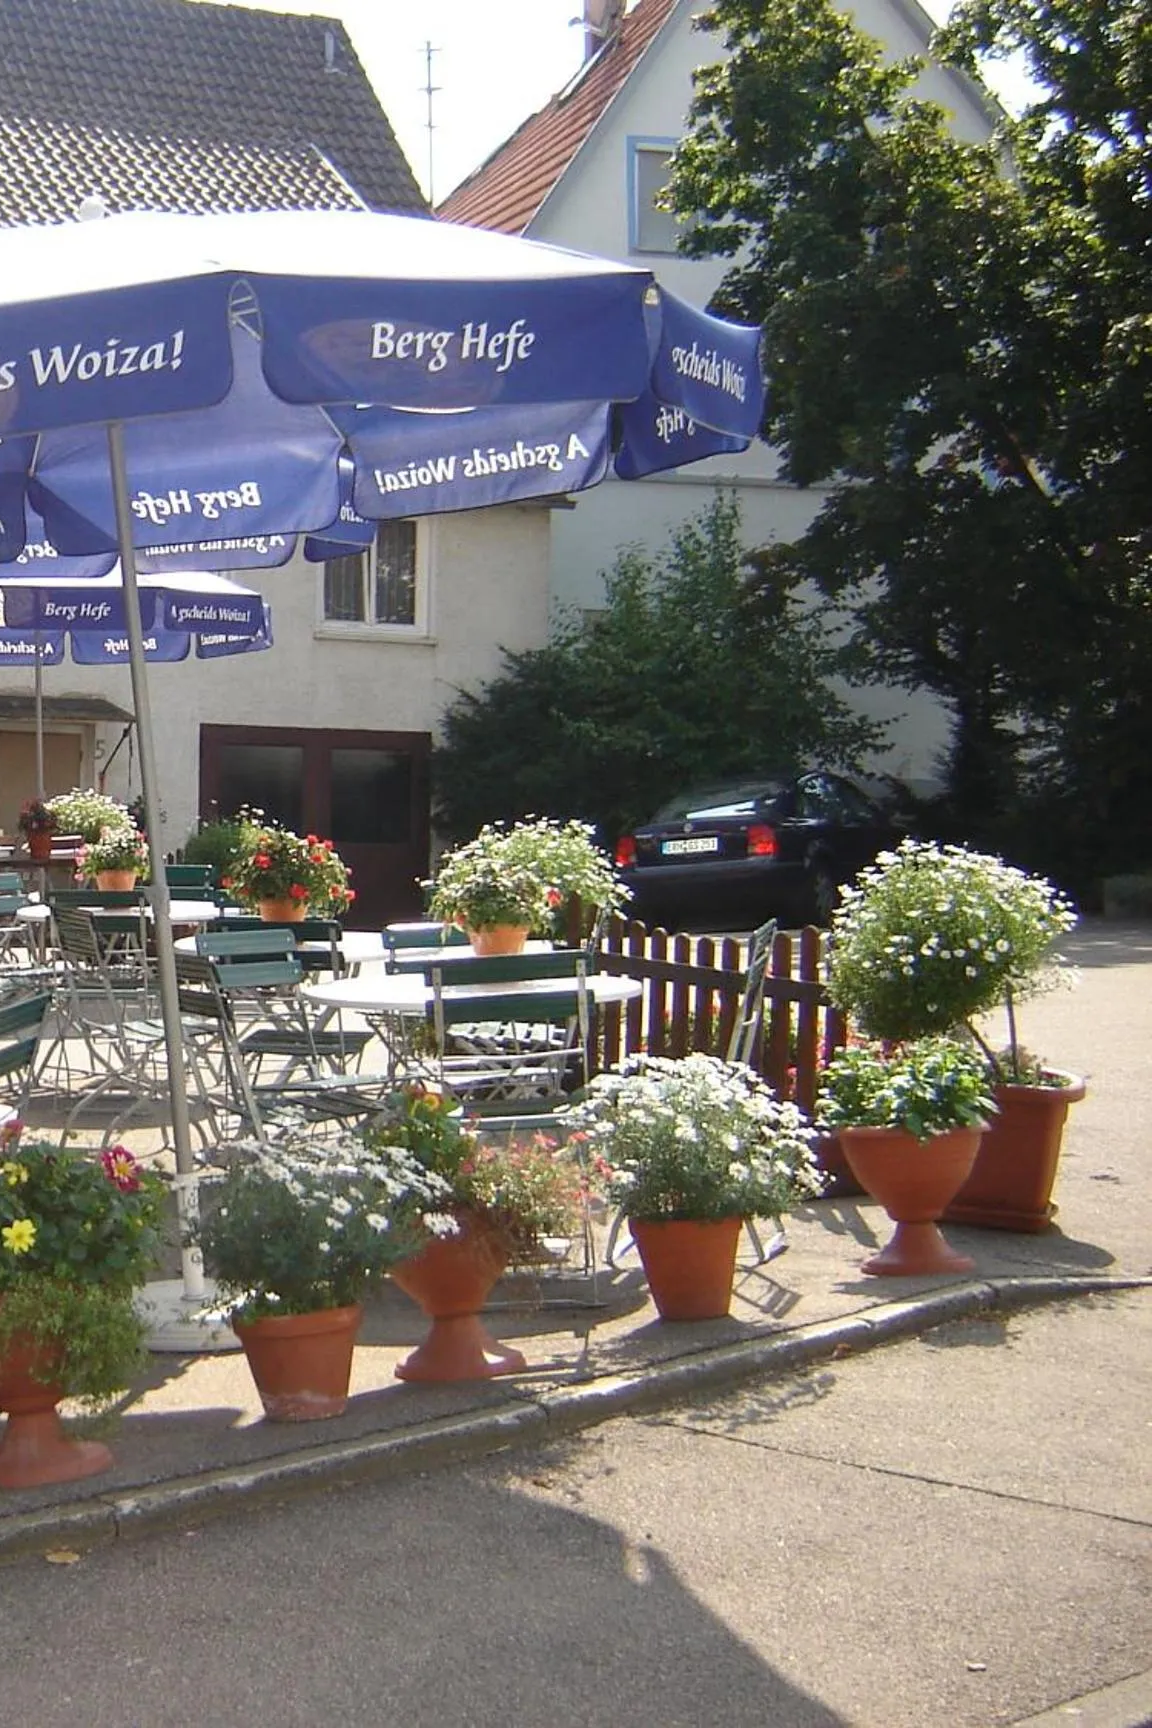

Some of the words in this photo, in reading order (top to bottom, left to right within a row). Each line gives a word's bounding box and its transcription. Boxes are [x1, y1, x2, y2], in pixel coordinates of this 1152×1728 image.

[28, 329, 185, 386] Woiza!
[371, 321, 455, 373] Berg
[460, 319, 536, 373] Hefe
[45, 602, 79, 621] Berg
